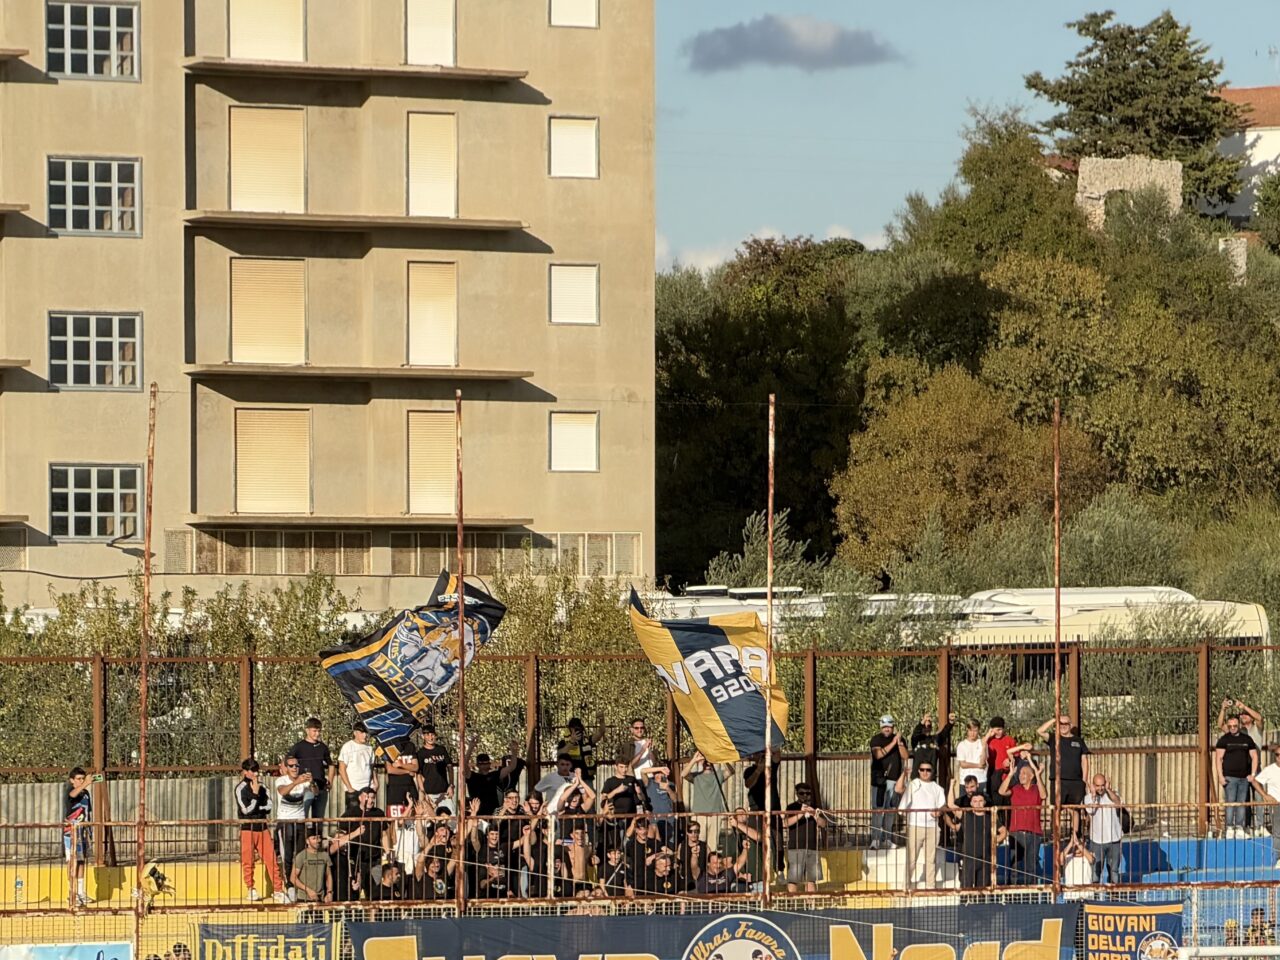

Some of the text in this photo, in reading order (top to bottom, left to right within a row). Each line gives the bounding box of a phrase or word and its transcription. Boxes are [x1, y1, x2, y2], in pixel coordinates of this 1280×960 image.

[1088, 914, 1156, 932] GIOVANI
[734, 921, 786, 959] Favara
[1088, 934, 1136, 952] DELLA
